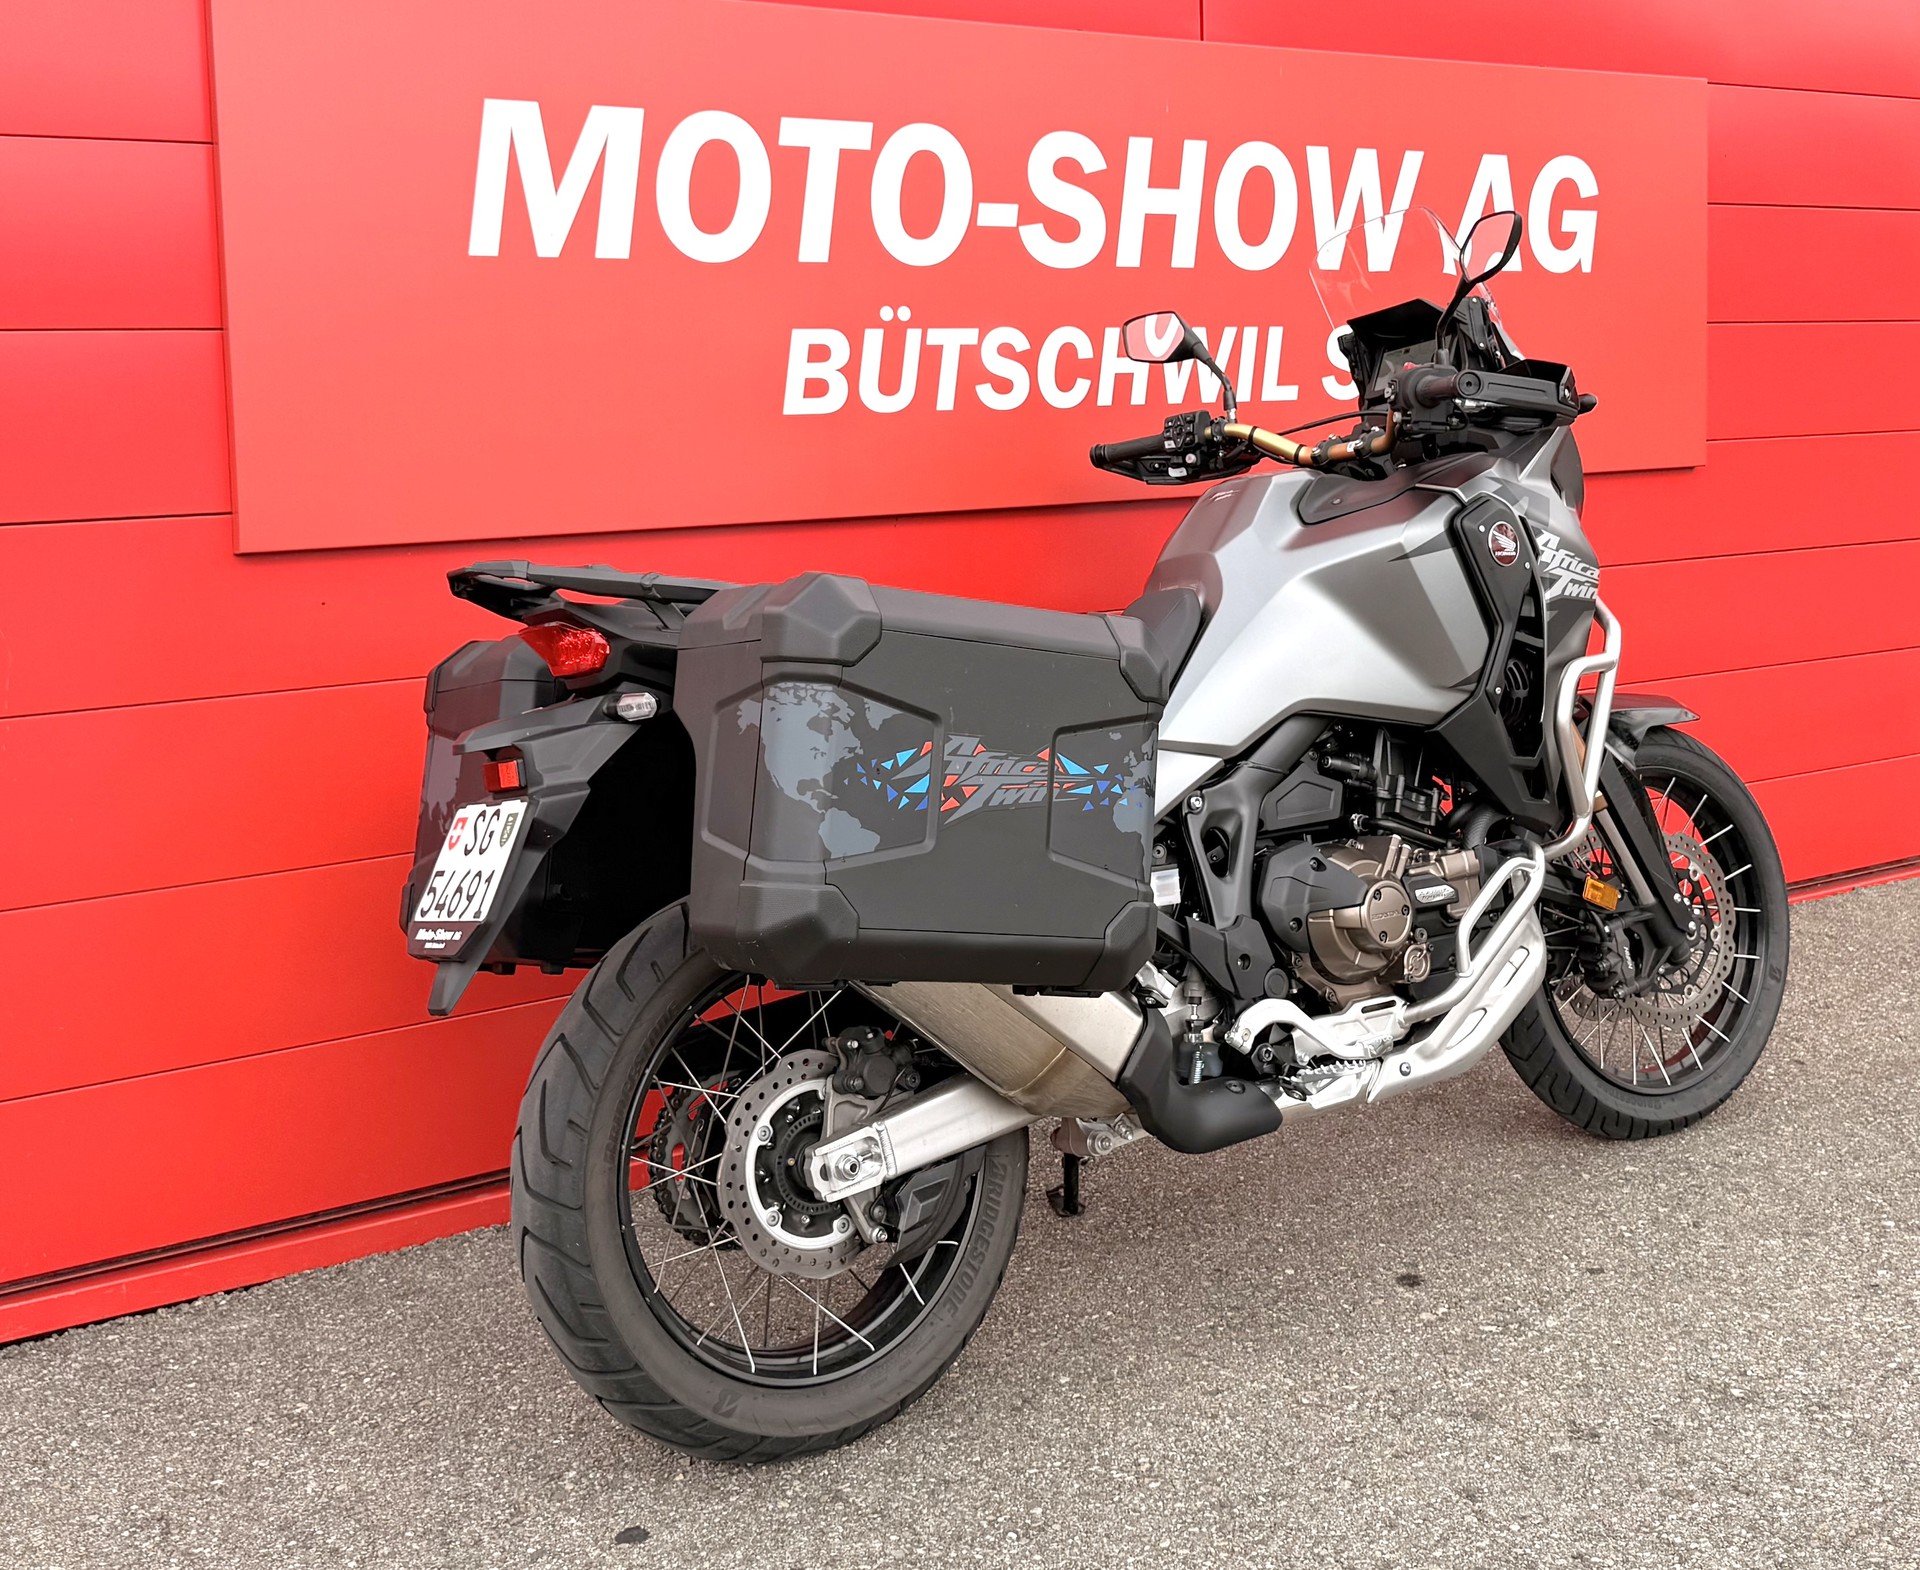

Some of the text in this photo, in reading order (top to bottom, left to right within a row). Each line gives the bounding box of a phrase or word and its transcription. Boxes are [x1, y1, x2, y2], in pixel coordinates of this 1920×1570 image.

[467, 97, 1600, 275] MOTO-SHOW AG
[782, 305, 1299, 416] BÜTSCHWIL
[1536, 529, 1600, 579] Africa
[1544, 567, 1600, 601] Twin
[463, 808, 501, 857] SG
[420, 868, 496, 919] 54691
